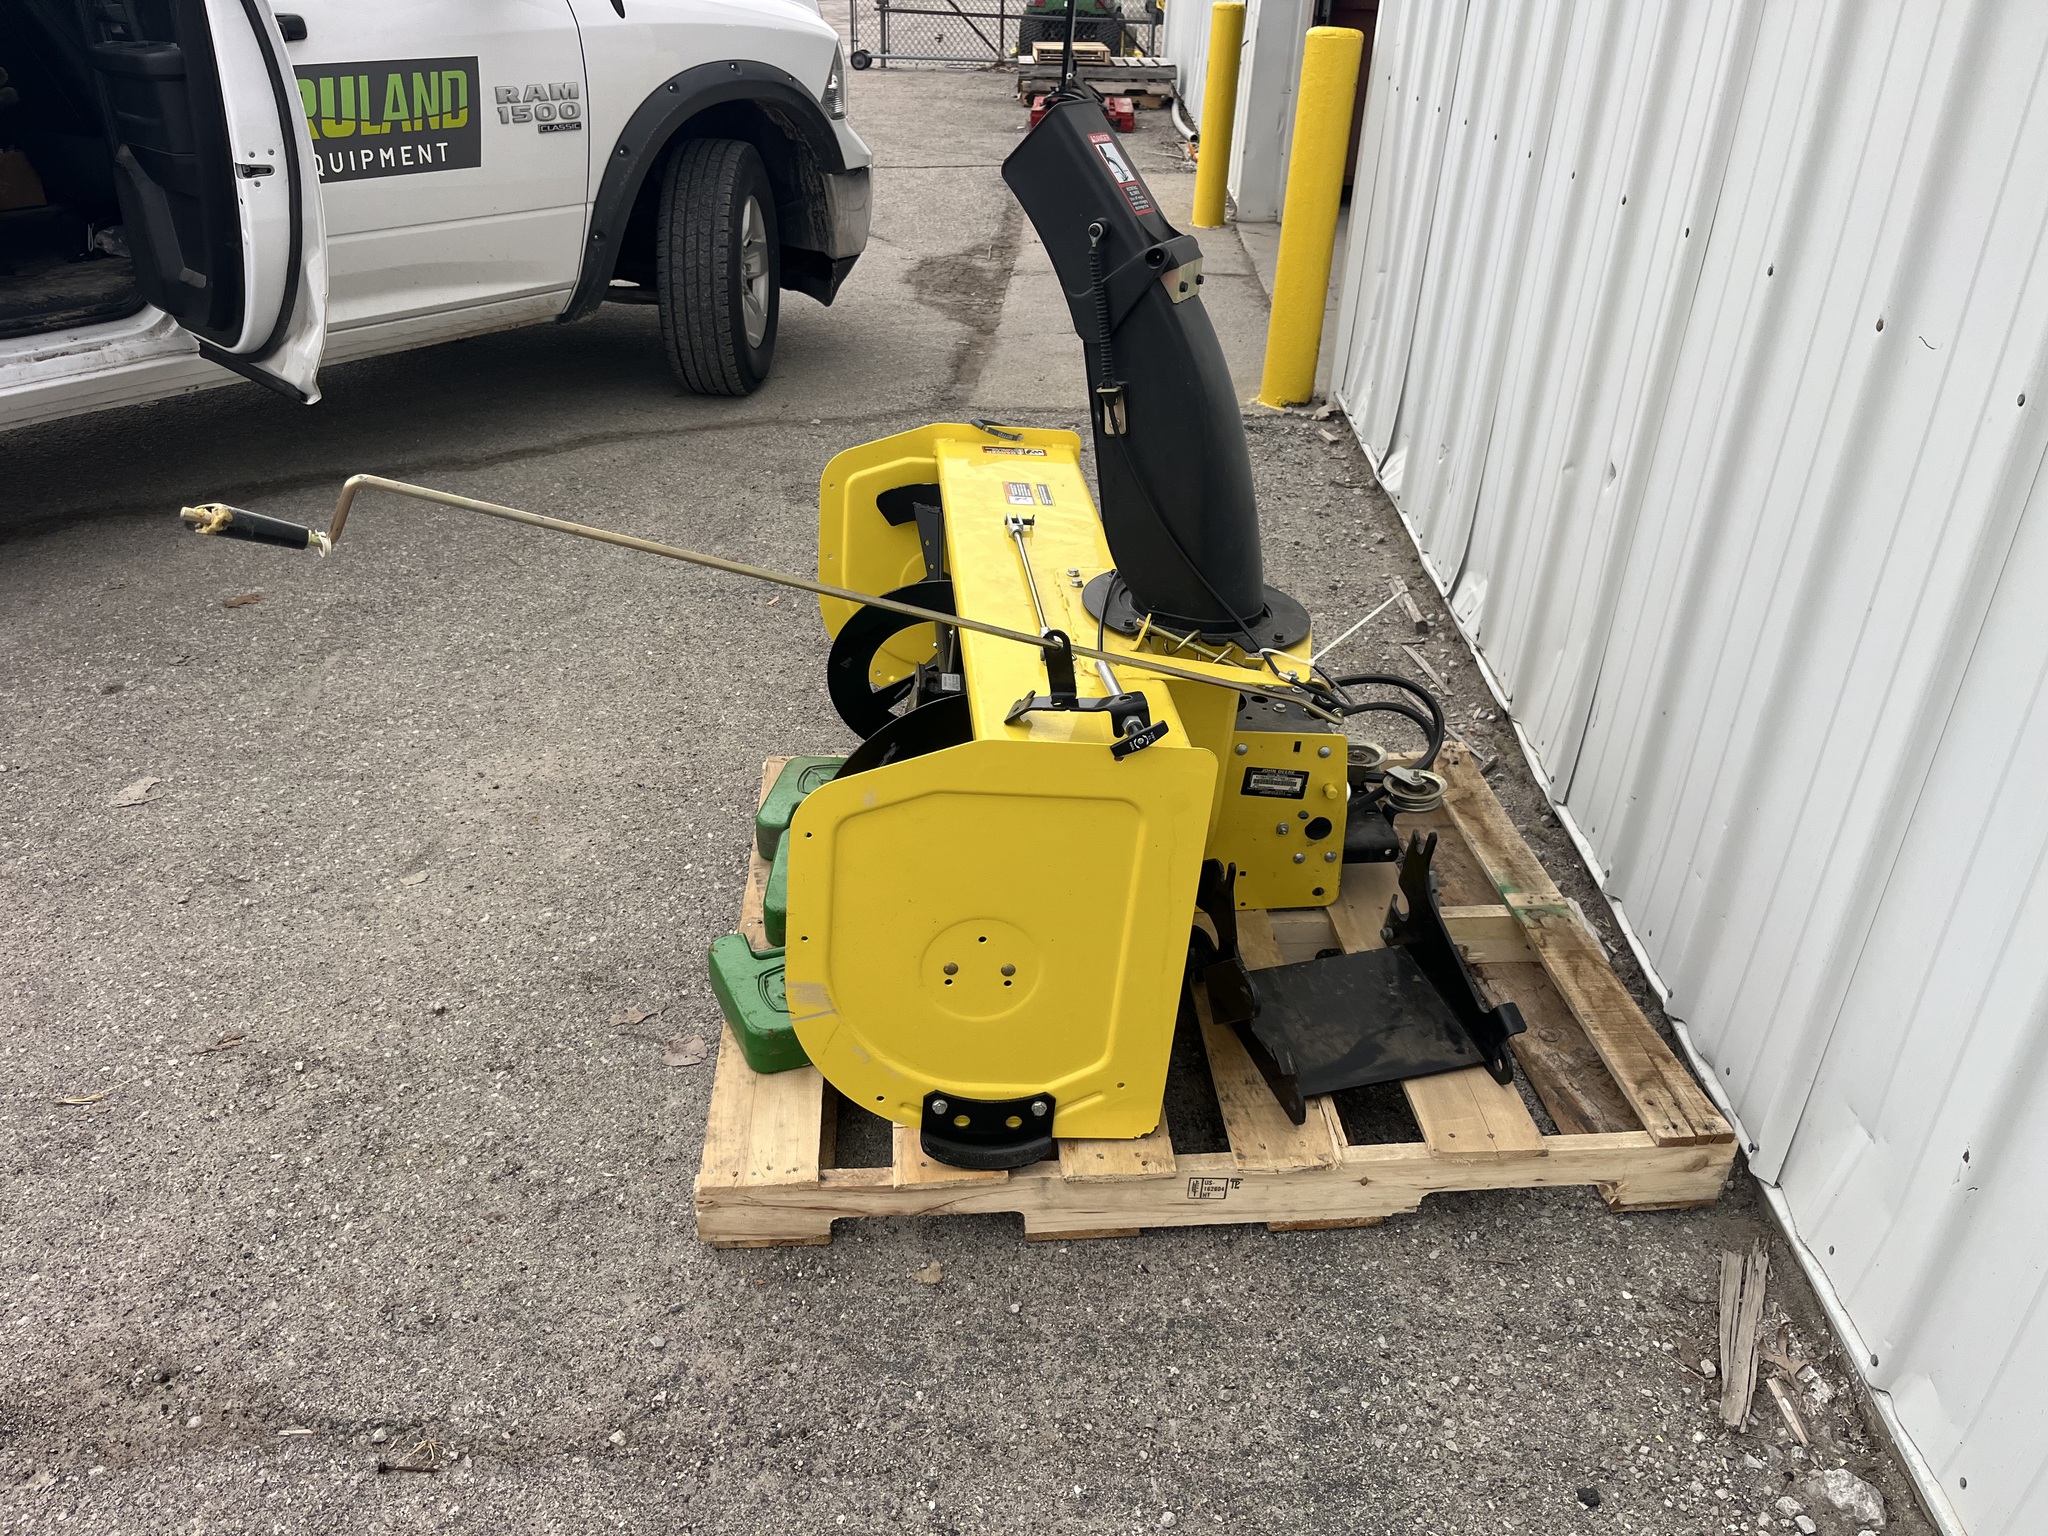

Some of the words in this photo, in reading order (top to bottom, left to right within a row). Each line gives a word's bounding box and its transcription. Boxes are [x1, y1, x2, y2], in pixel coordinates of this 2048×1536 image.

[494, 82, 580, 105] RAM
[497, 101, 581, 124] 1500
[540, 123, 581, 132] CLASSIC
[314, 142, 449, 177] QUIPMENT
